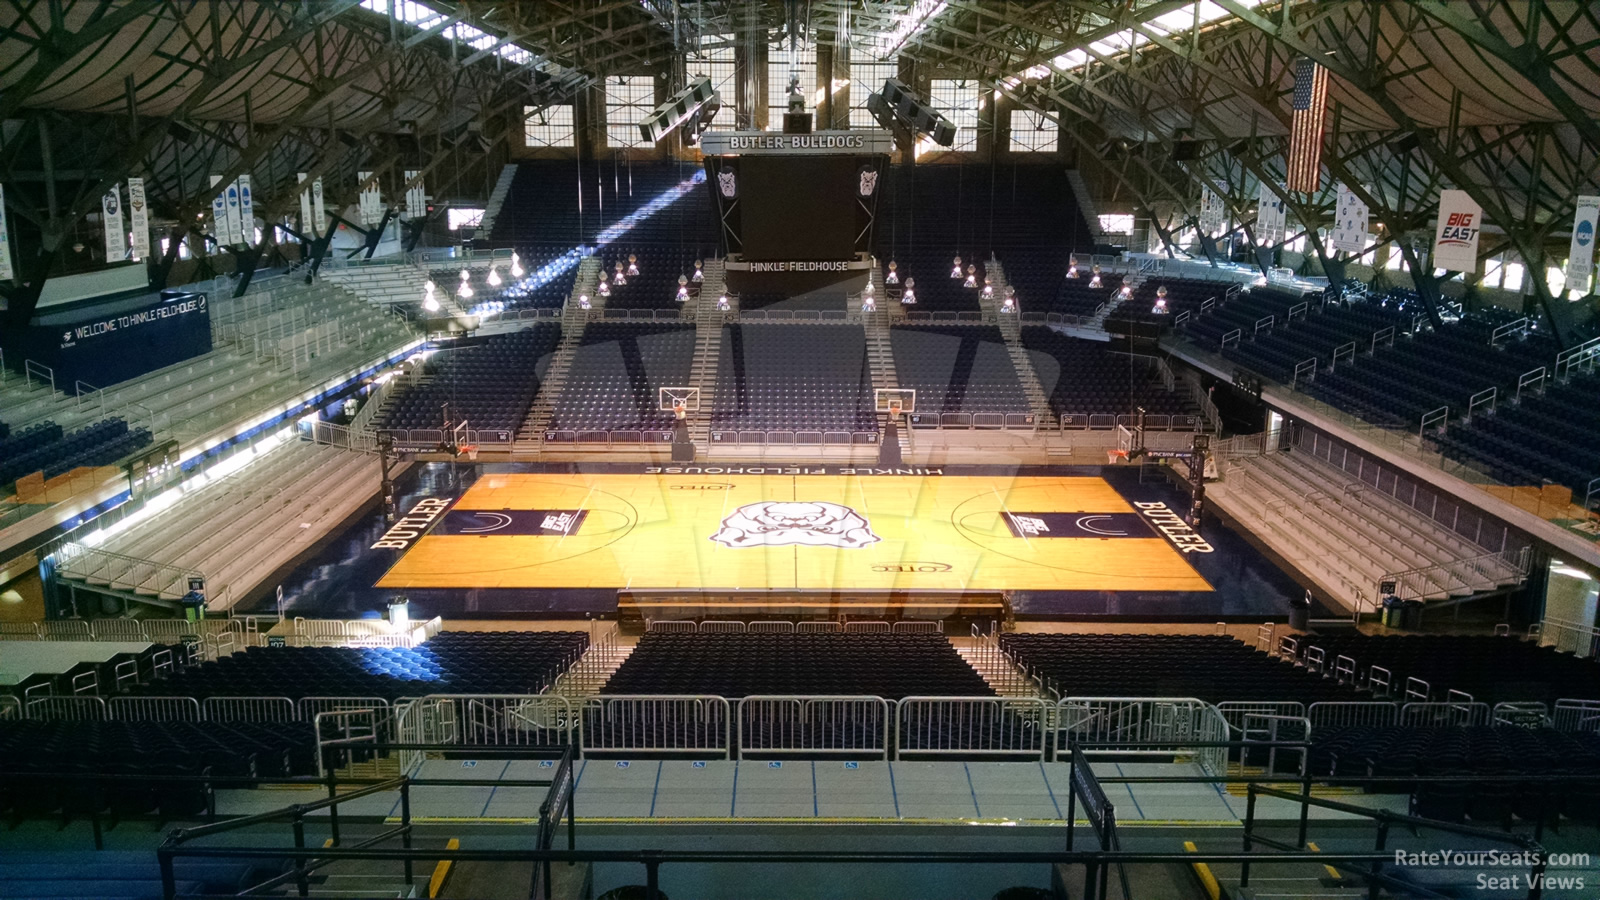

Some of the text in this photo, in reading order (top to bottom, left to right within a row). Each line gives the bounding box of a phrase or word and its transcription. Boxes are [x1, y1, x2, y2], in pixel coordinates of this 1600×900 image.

[730, 134, 864, 149] BUTLER BULLDOGS
[1447, 212, 1474, 227] BIG
[1441, 226, 1479, 241] EAST
[750, 261, 848, 272] HINKLE FIELDHOUSE
[75, 299, 198, 339] WELCOME TO HINKLE FIELDHOUSE
[645, 466, 944, 475] HINKLE FIELDHOUSE
[369, 497, 453, 550] BUTLER
[1133, 501, 1215, 553] BUTLER
